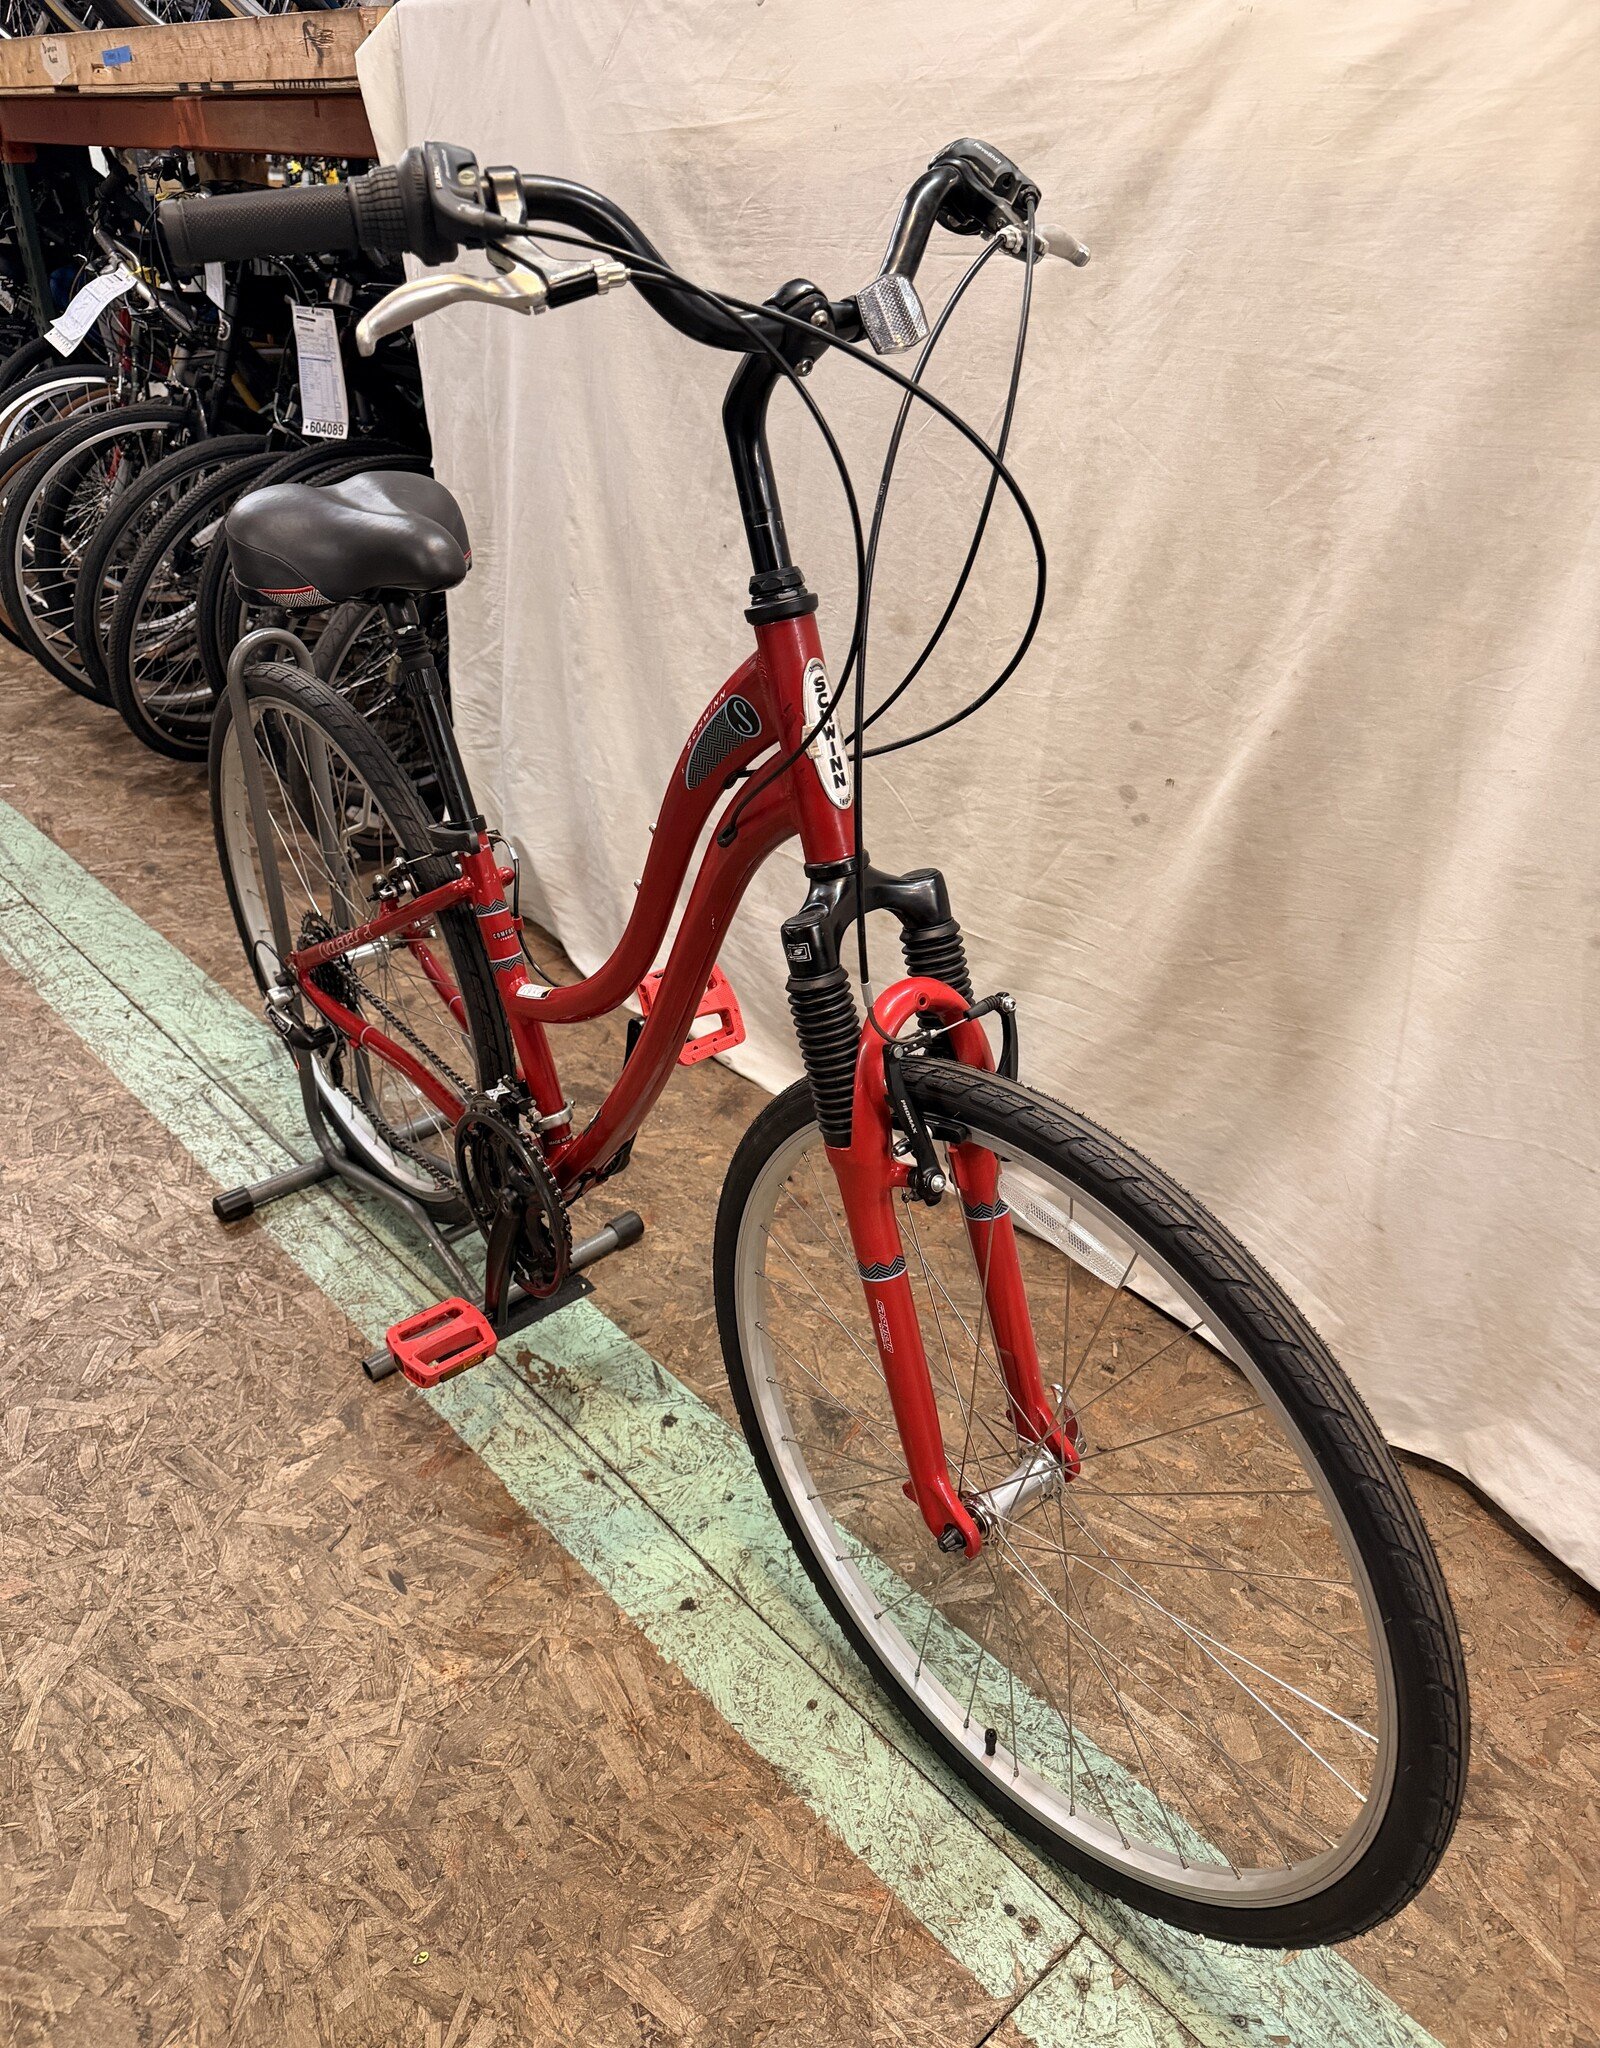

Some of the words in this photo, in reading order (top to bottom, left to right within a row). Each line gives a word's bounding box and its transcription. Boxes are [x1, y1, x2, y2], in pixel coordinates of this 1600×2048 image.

[310, 421, 344, 436] 604089
[686, 690, 726, 750] SCHWINN
[492, 926, 516, 939] COMFOR
[900, 1099, 918, 1134] PROMAX
